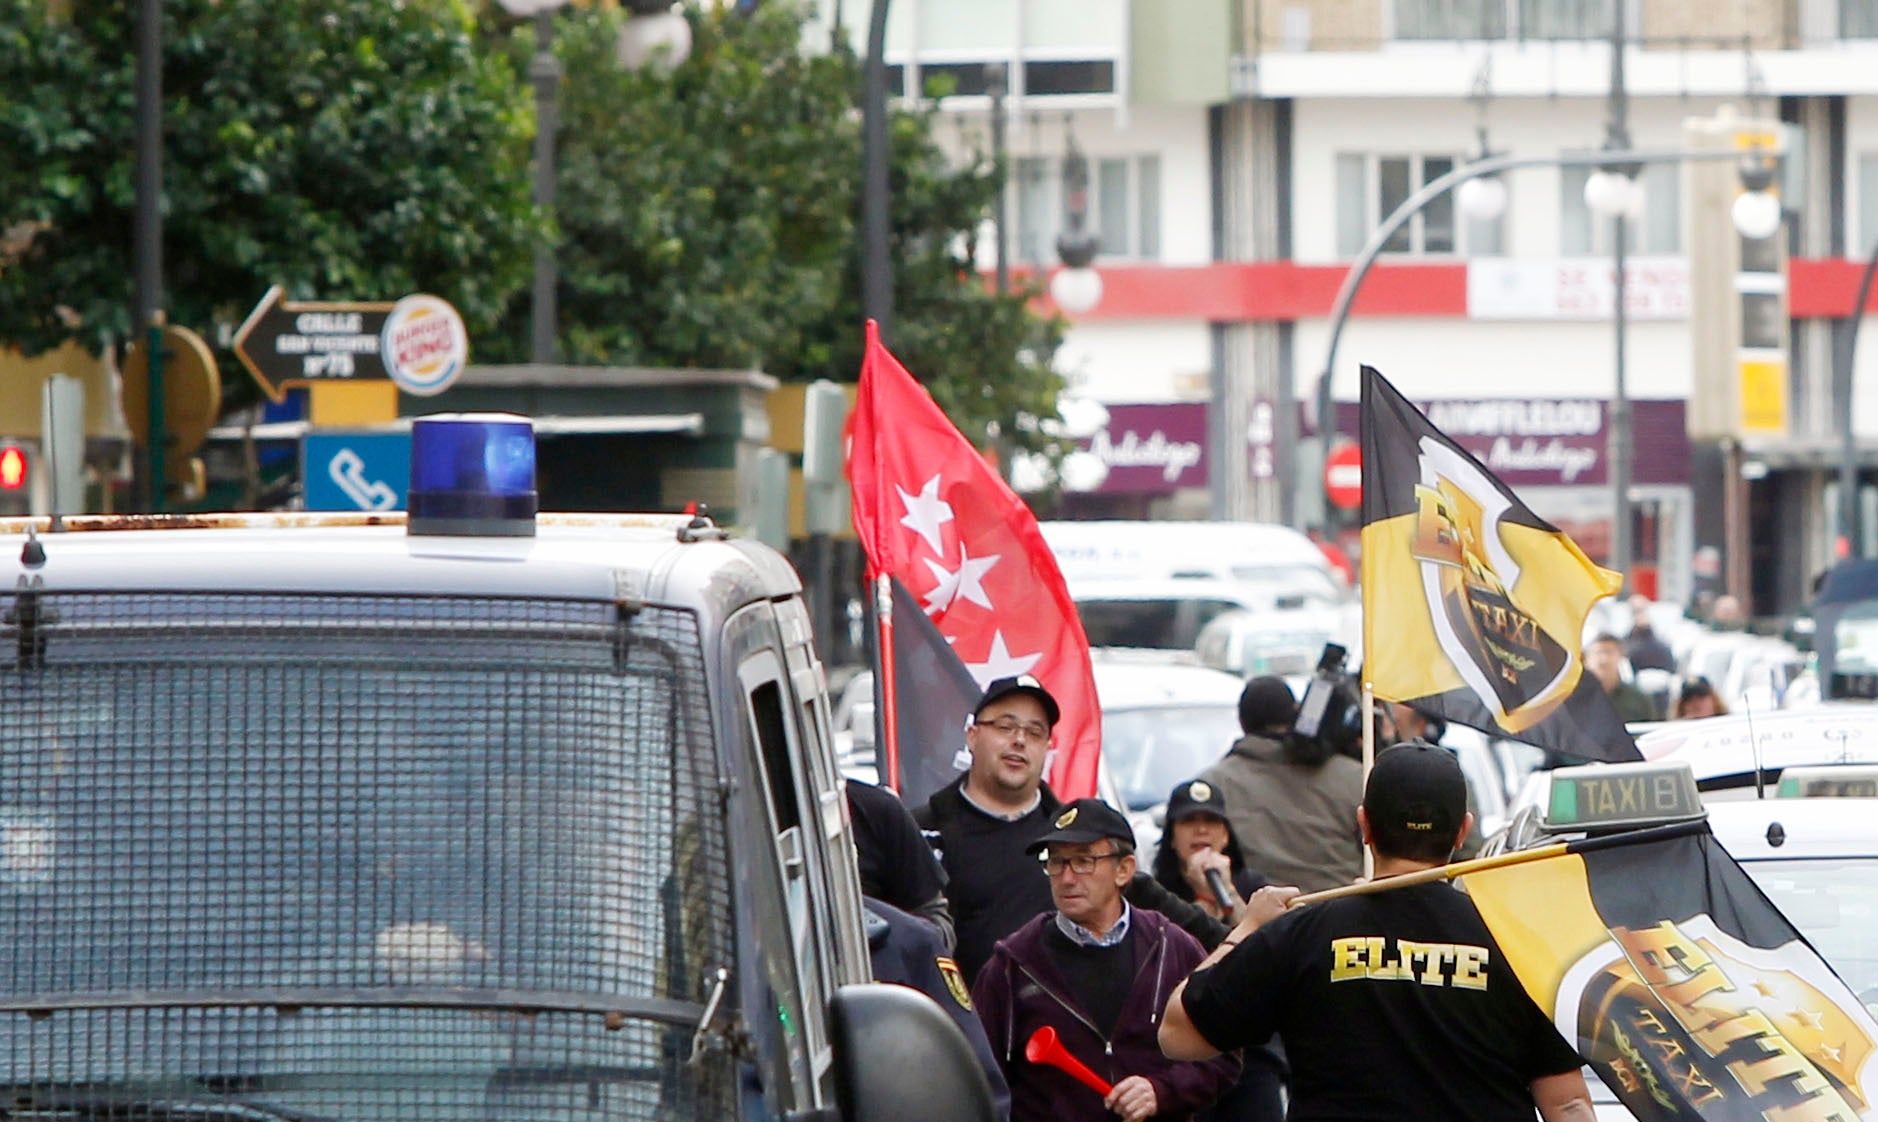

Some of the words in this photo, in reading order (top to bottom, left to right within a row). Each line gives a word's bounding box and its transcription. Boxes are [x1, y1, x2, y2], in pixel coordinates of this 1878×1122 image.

[1470, 599, 1539, 650] TAXI
[1581, 775, 1648, 815] TAXI
[1406, 821, 1433, 831] ELITE
[1330, 936, 1490, 992] ELITE
[1633, 1006, 1726, 1108] TAXI
